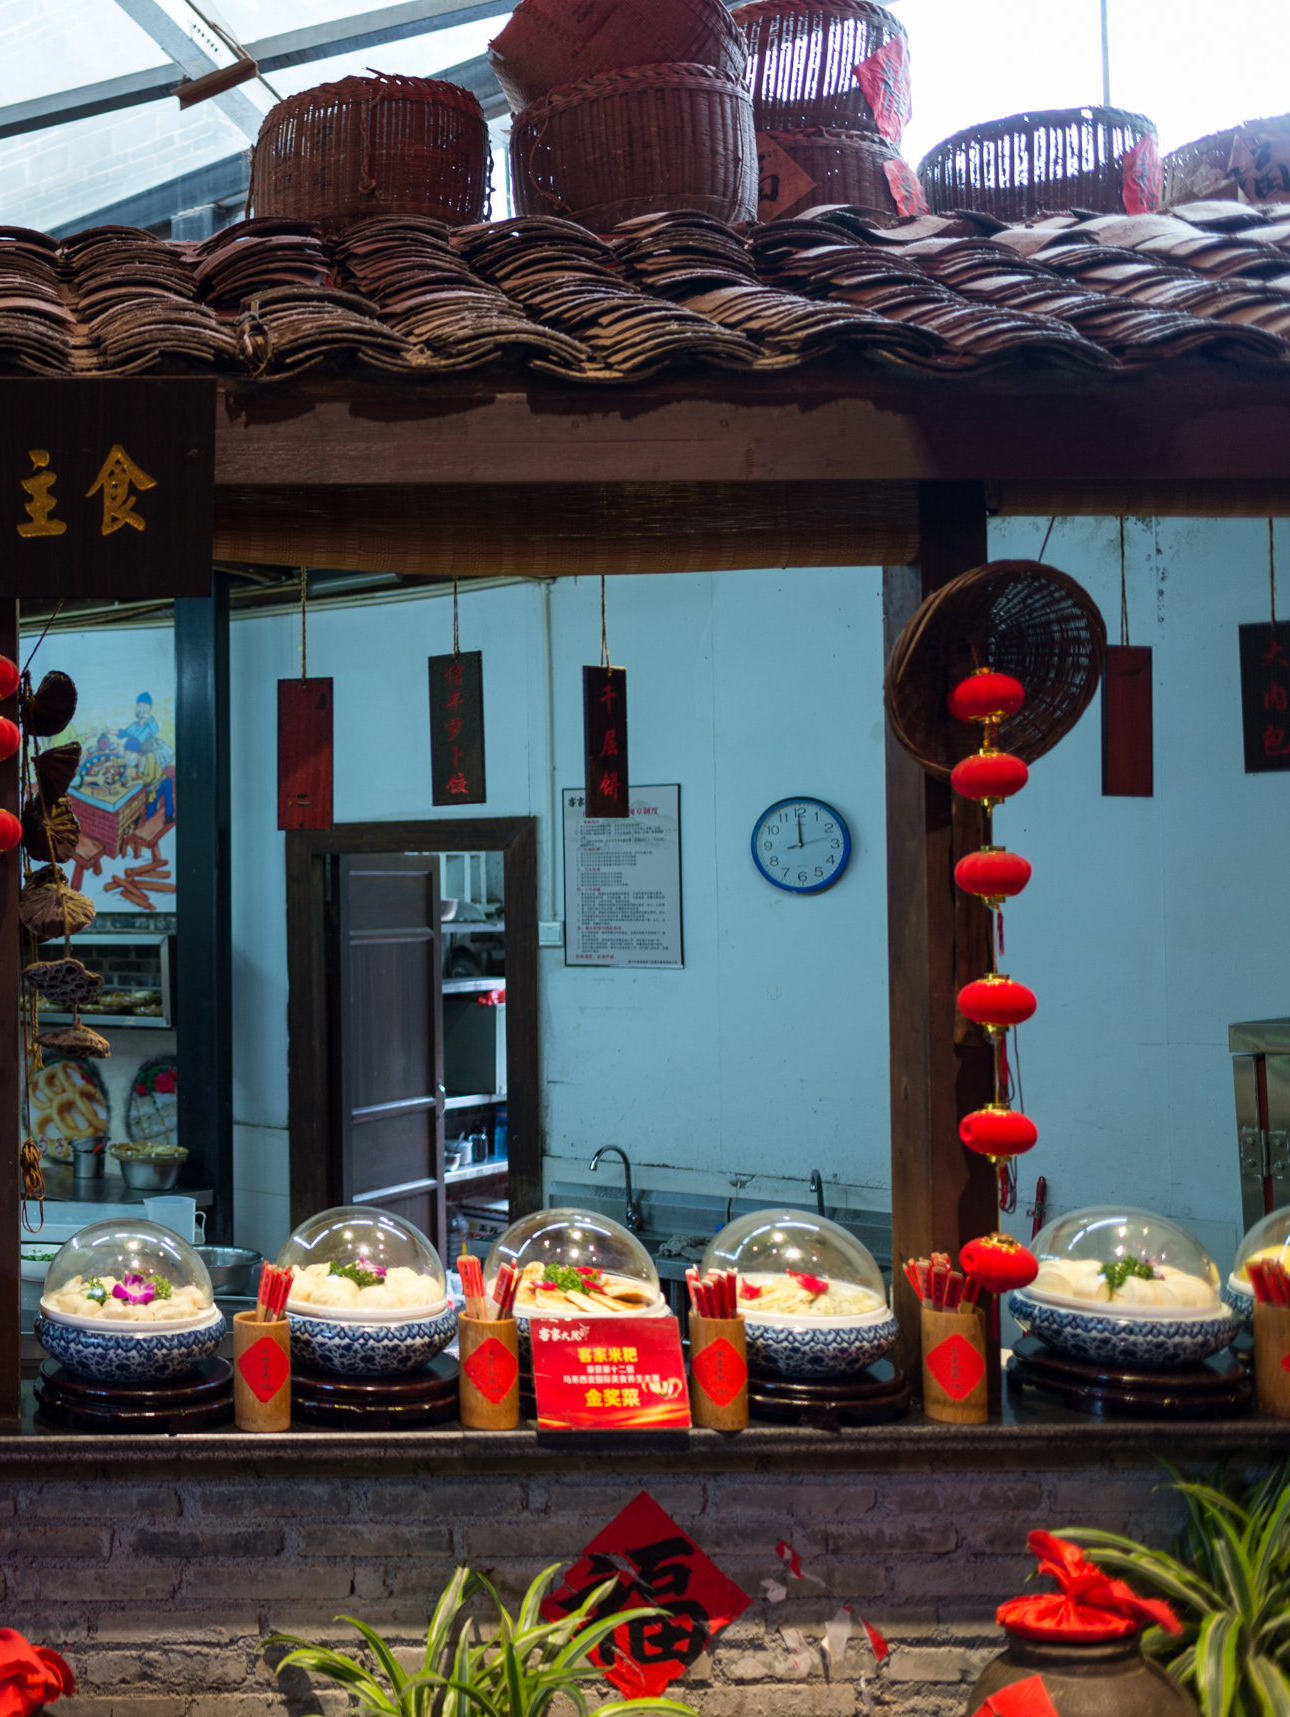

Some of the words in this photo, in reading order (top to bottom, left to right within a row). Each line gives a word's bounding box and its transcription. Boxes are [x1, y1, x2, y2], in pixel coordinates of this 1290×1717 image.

[1261, 639, 1290, 756] 大肉包
[599, 684, 620, 801] 千层饼
[779, 813, 788, 823] 11
[794, 807, 806, 818] 12
[815, 811, 819, 822] 1
[767, 825, 780, 835] 10
[824, 823, 834, 833] 2
[763, 841, 773, 851] 9
[831, 838, 840, 849] 3
[770, 855, 779, 867] 8
[826, 854, 835, 865] 4
[781, 867, 790, 878] 7
[797, 871, 807, 882] 6
[814, 867, 824, 877] 5
[577, 1347, 638, 1363] 客家米粑
[586, 1364, 635, 1374] 荣获第十二届
[584, 1388, 641, 1407] 金奖菜
